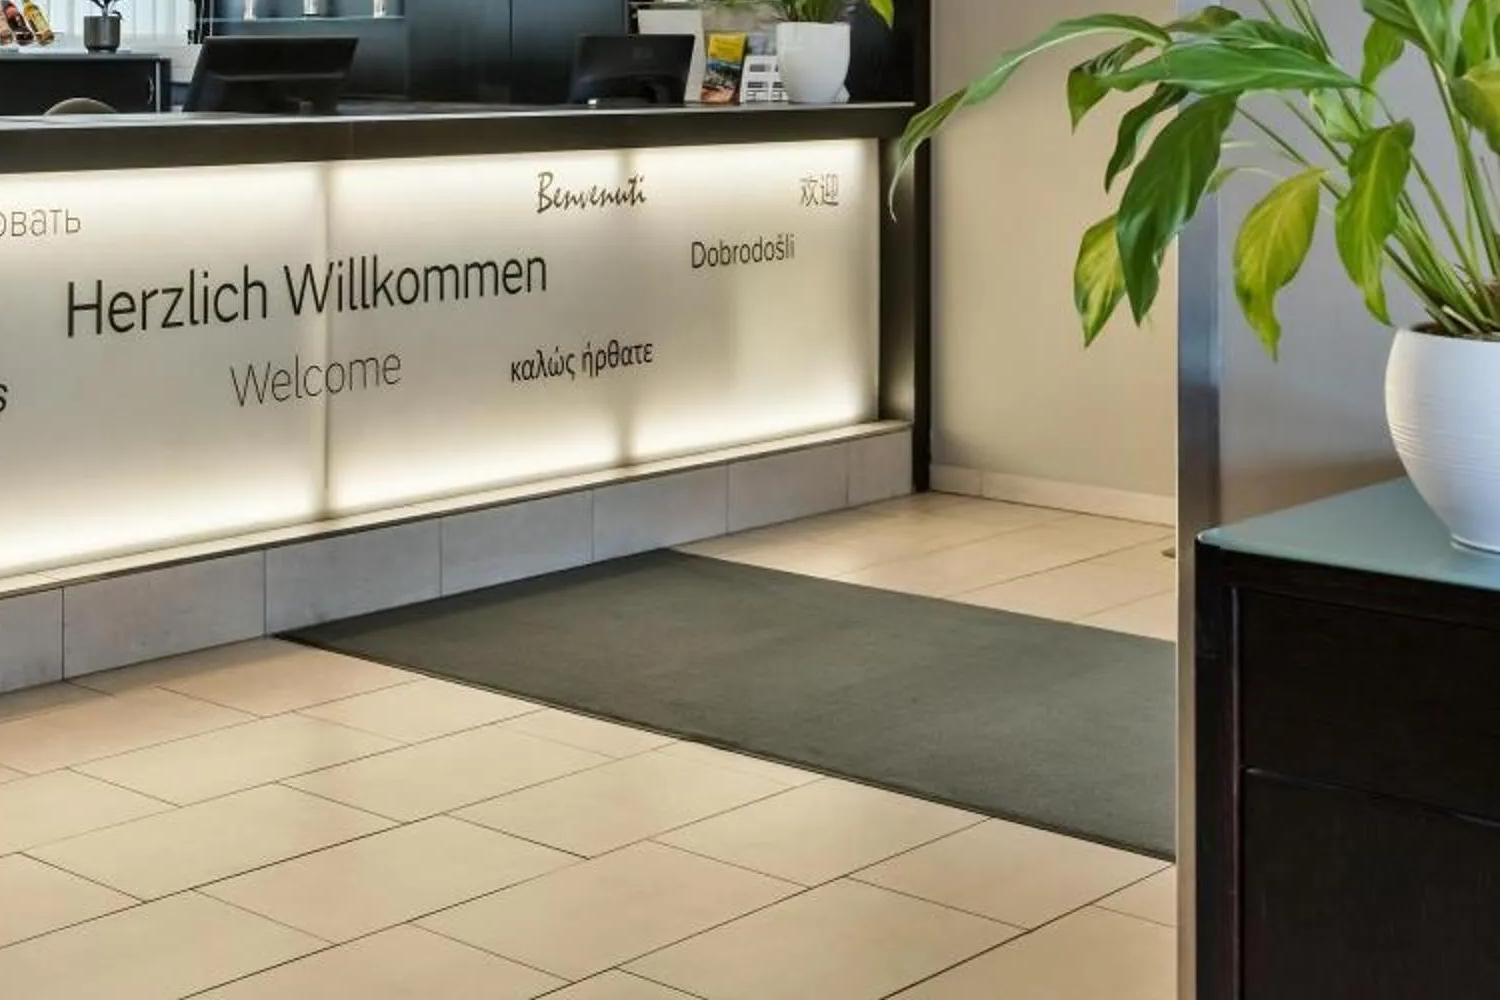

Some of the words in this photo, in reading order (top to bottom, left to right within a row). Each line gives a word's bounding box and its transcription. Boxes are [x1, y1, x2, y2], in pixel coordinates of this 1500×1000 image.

[536, 171, 647, 214] Benvenuti
[799, 171, 840, 208] 欢迎
[691, 232, 795, 269] Dobrodošli
[67, 264, 268, 339] Herzlich
[283, 253, 547, 317] Willkommen
[229, 350, 403, 408] Welcome
[510, 344, 577, 384] καλώς
